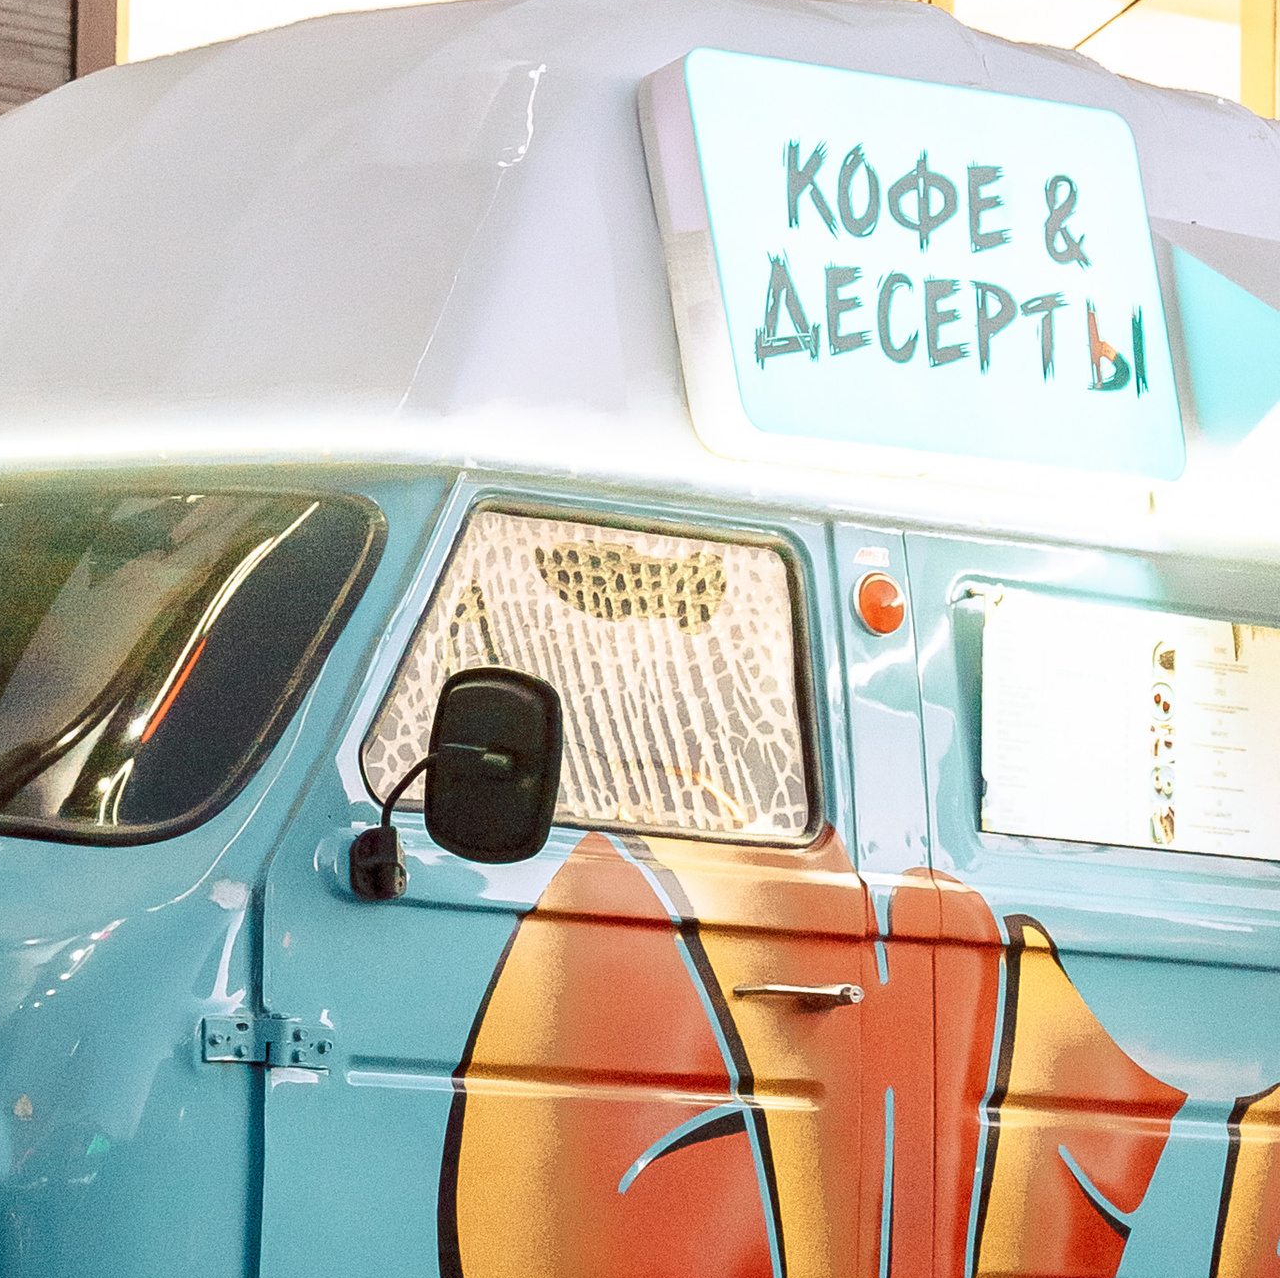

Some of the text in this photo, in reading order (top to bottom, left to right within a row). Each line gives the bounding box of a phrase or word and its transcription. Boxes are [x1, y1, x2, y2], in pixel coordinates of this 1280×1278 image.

[784, 138, 1093, 269] КОФЕ &
[755, 250, 1150, 399] ДЕСЕРТЫ
